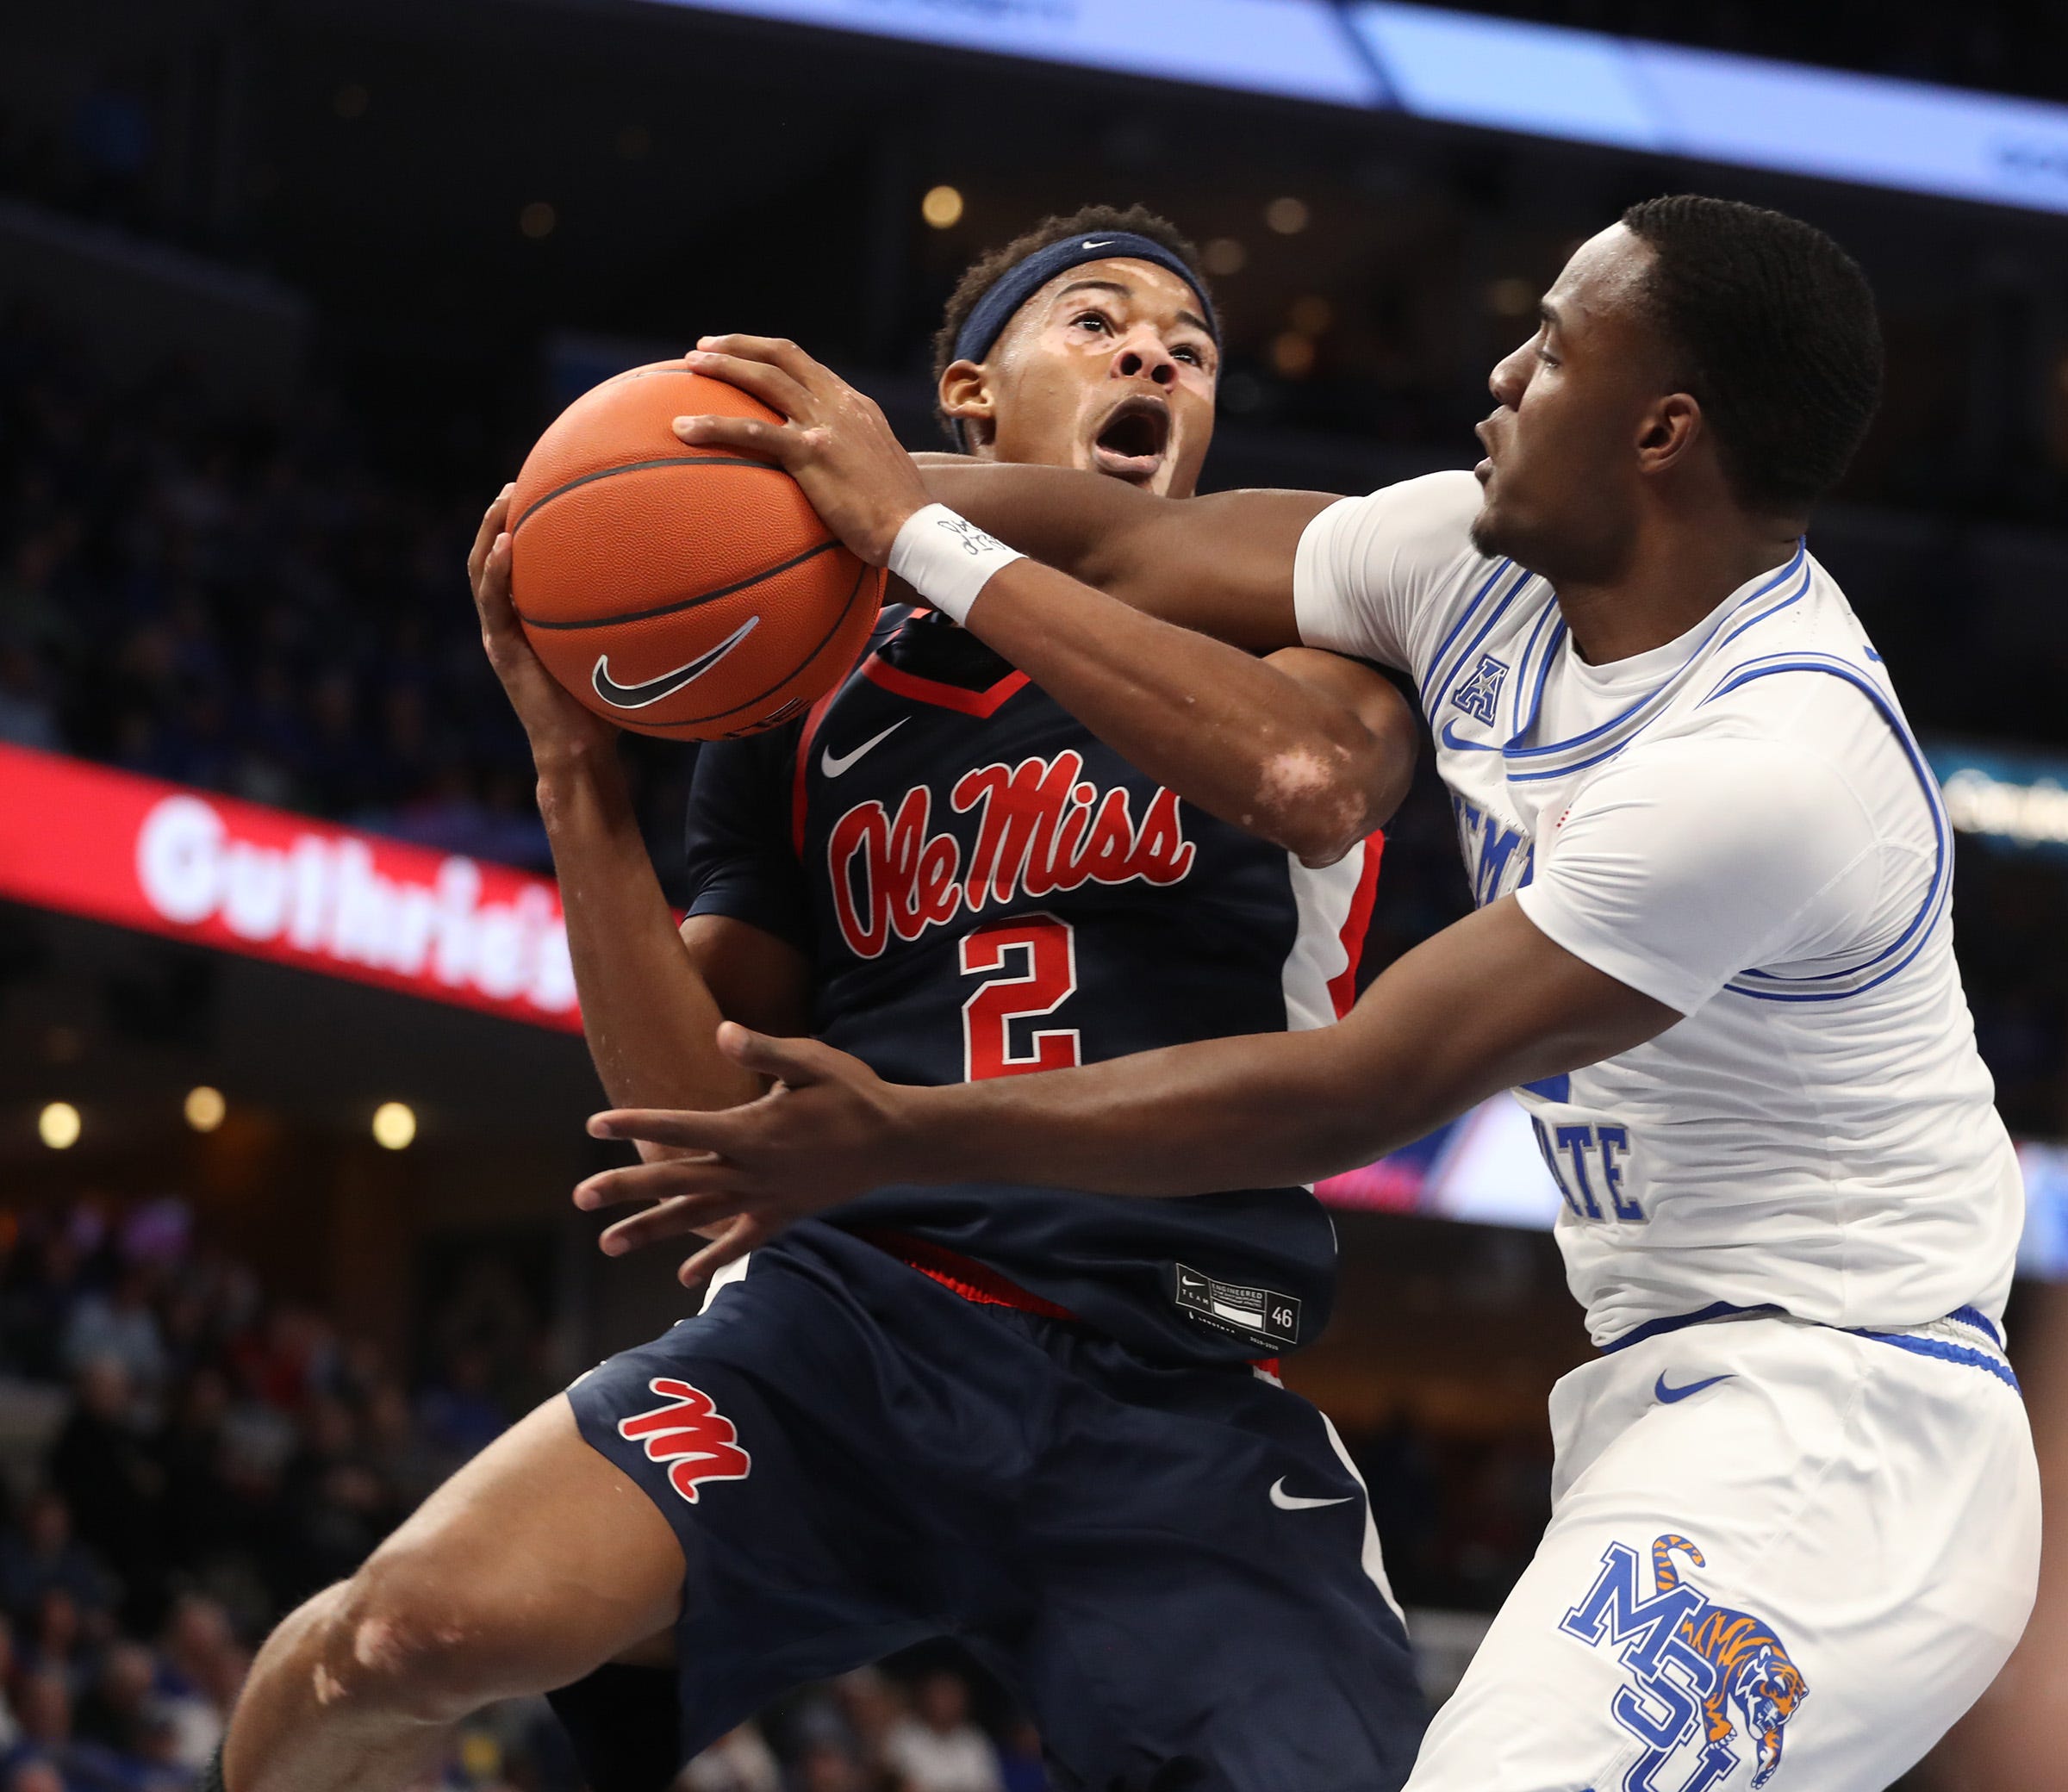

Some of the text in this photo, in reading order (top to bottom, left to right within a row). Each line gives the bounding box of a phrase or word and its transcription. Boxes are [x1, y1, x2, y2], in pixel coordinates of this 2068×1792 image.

[828, 750, 1196, 959] Ole Miss
[959, 911, 1081, 1083] 2
[1181, 1289, 1209, 1304] TEAM
[1212, 1284, 1263, 1299] ENGINEERED
[1271, 1306, 1292, 1328] 46
